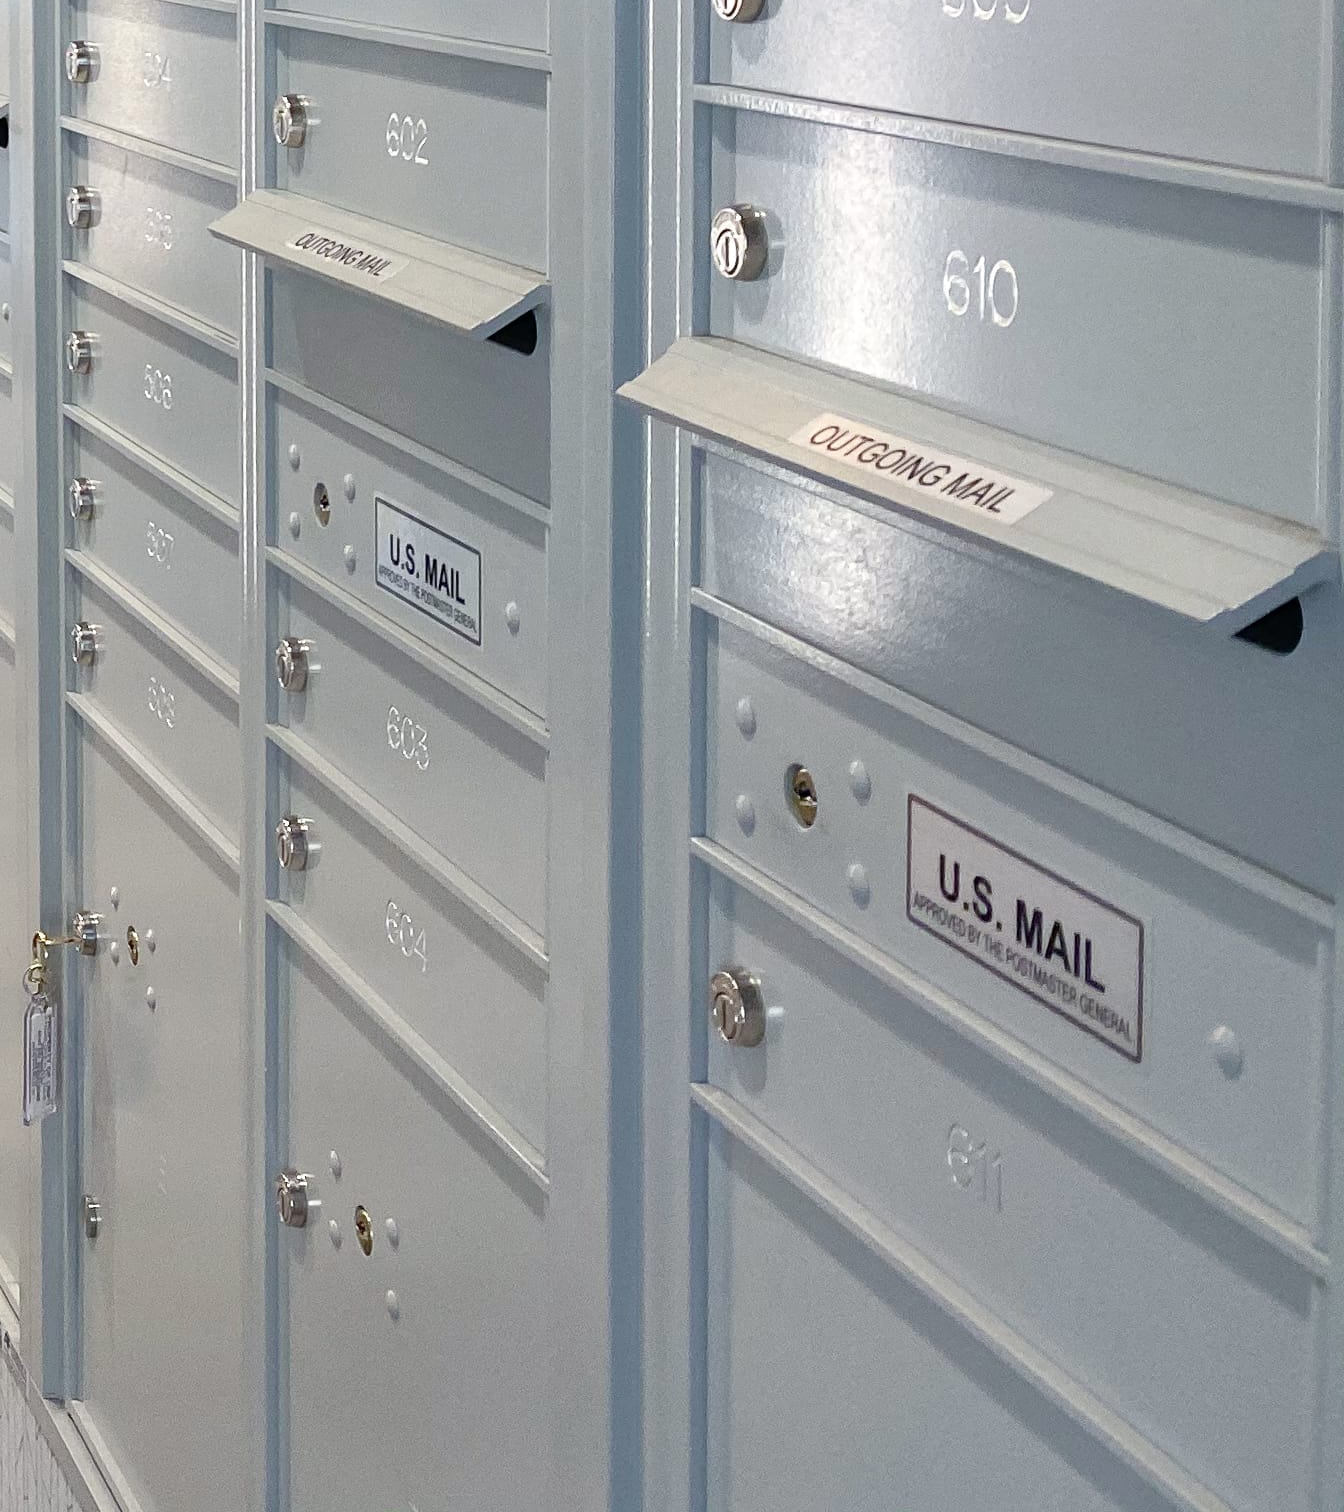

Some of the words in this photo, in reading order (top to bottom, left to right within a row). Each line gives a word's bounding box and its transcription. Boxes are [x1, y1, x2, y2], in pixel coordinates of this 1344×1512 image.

[386, 112, 429, 165] 602
[295, 232, 364, 265] OUTGOING
[354, 254, 392, 277] MAIL
[942, 249, 1020, 328] 610
[810, 425, 952, 486] OUTGOING
[942, 473, 1016, 514] MAIL
[389, 533, 420, 579] U.S.
[424, 553, 466, 606] MAIL
[387, 704, 430, 771] 603
[386, 899, 427, 973] 604
[938, 854, 1003, 932] U.S.
[1015, 899, 1106, 994] MAIL
[912, 891, 967, 939] APPROVED
[967, 924, 982, 946] BY
[981, 931, 1006, 961] THE
[1005, 946, 1078, 1006] POSTMASTER
[1079, 993, 1134, 1043] GENERAL
[946, 1123, 1004, 1212] 611
